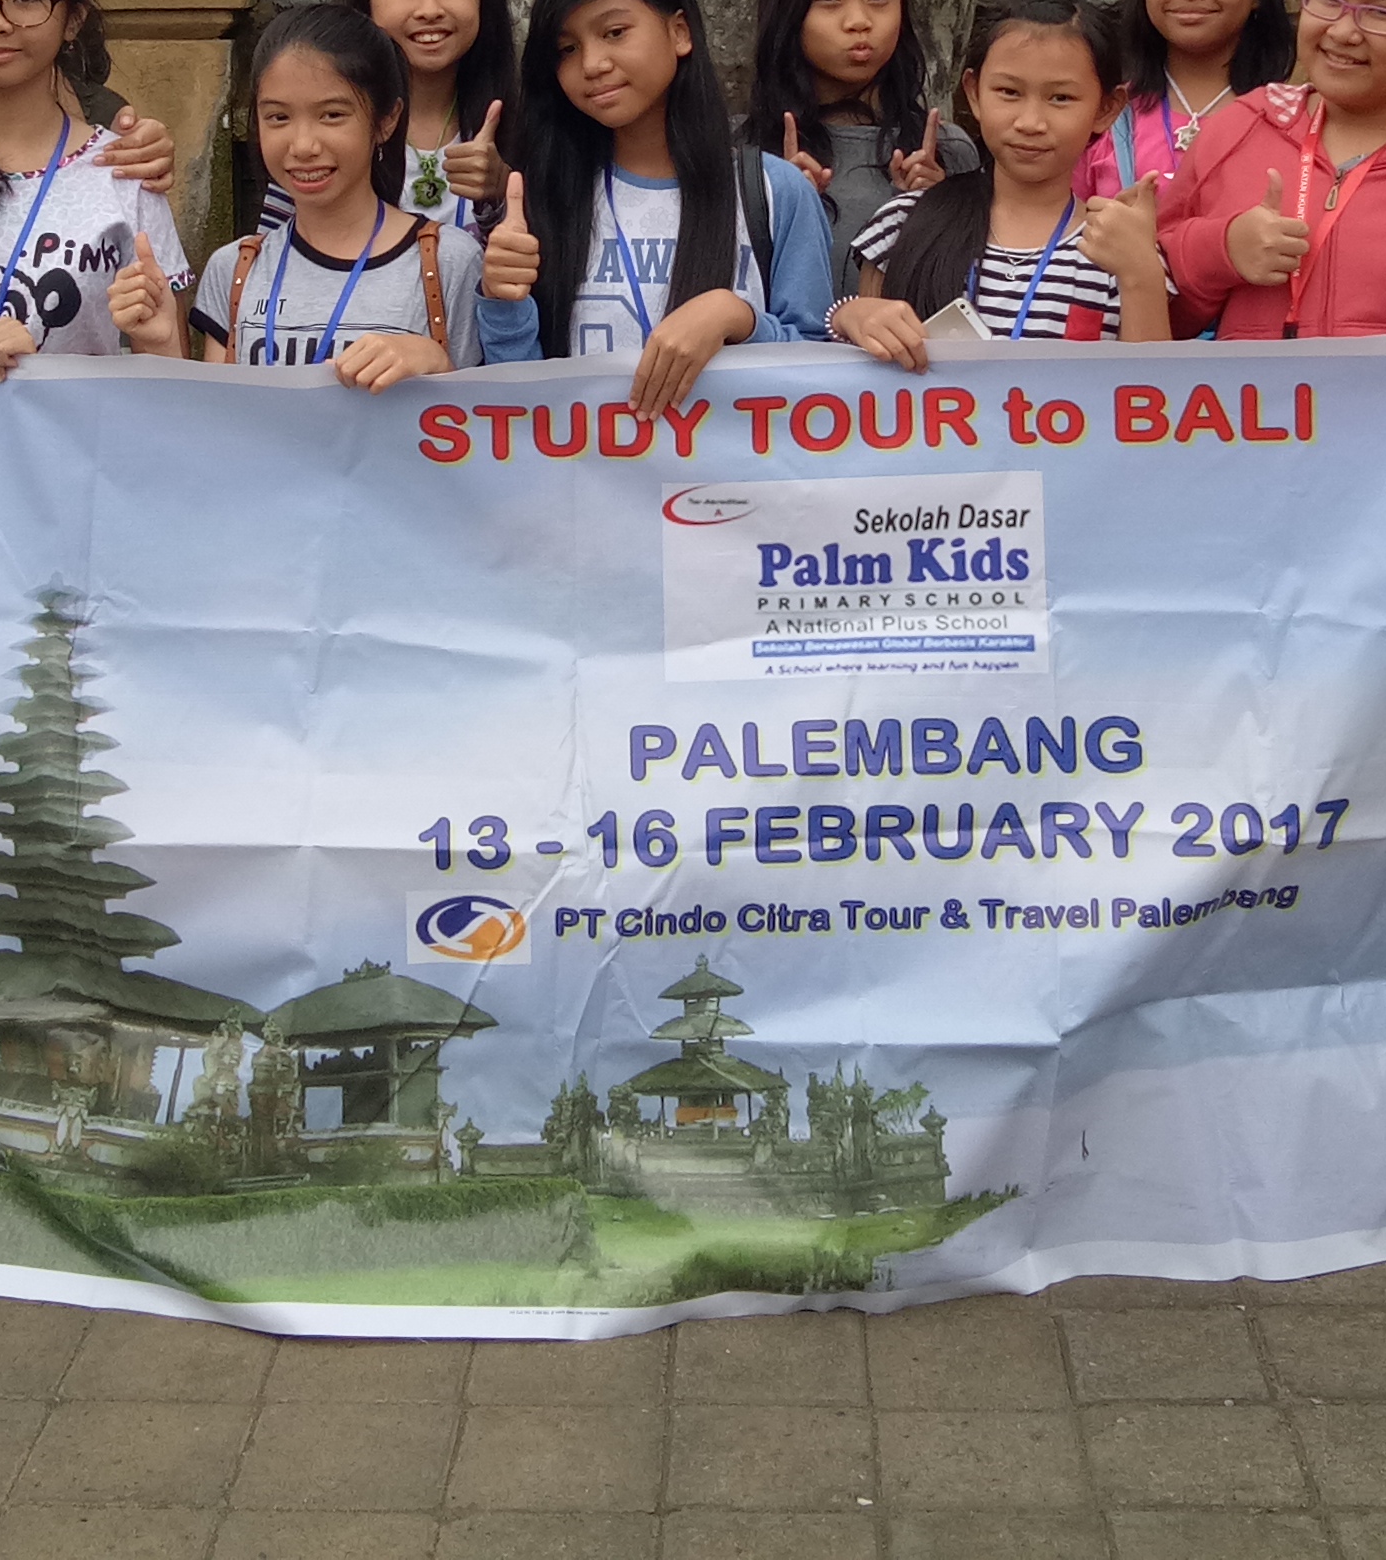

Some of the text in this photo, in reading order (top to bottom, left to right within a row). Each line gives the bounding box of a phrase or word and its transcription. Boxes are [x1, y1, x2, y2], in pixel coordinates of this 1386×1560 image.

[253, 298, 287, 316] JUT
[416, 381, 1314, 463] STUDY TOUR to BALI
[854, 503, 1031, 534] Sekolah Dasar
[757, 536, 1030, 588] Palm Kids
[757, 590, 1026, 611] PRIMARY SCHOOL
[765, 613, 1009, 635] A National Plus School
[629, 715, 1143, 783] PALEMBANG
[417, 797, 1351, 871] 13 - 16 FEBRUARY 2017
[554, 878, 1299, 941] PT Cindo Citra Tour & Travel Palembang
